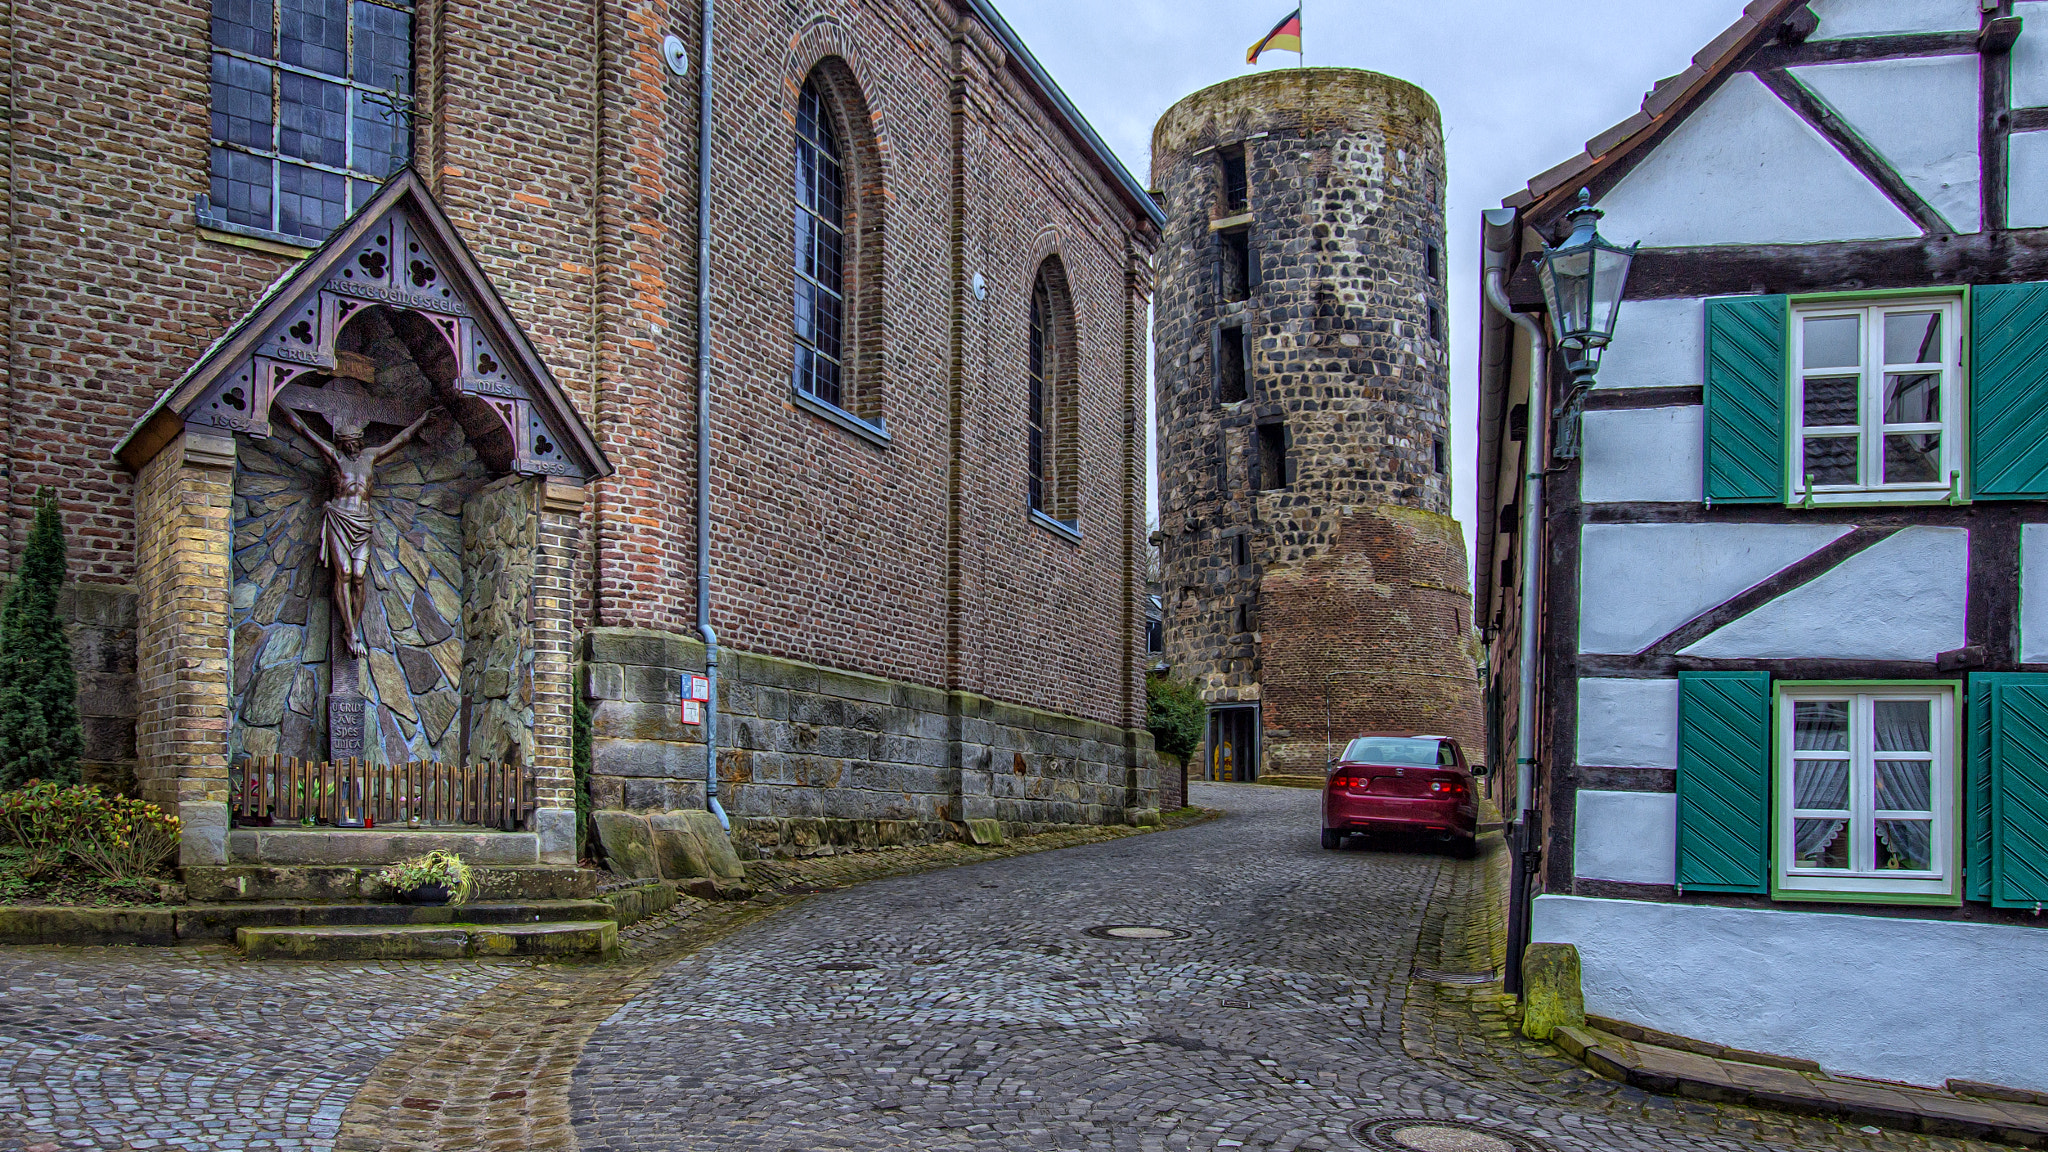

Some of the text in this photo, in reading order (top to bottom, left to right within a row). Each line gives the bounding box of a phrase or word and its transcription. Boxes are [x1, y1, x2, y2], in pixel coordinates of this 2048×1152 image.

[278, 347, 320, 363] CRUX
[536, 461, 565, 475] 1959
[338, 714, 357, 726] AVE
